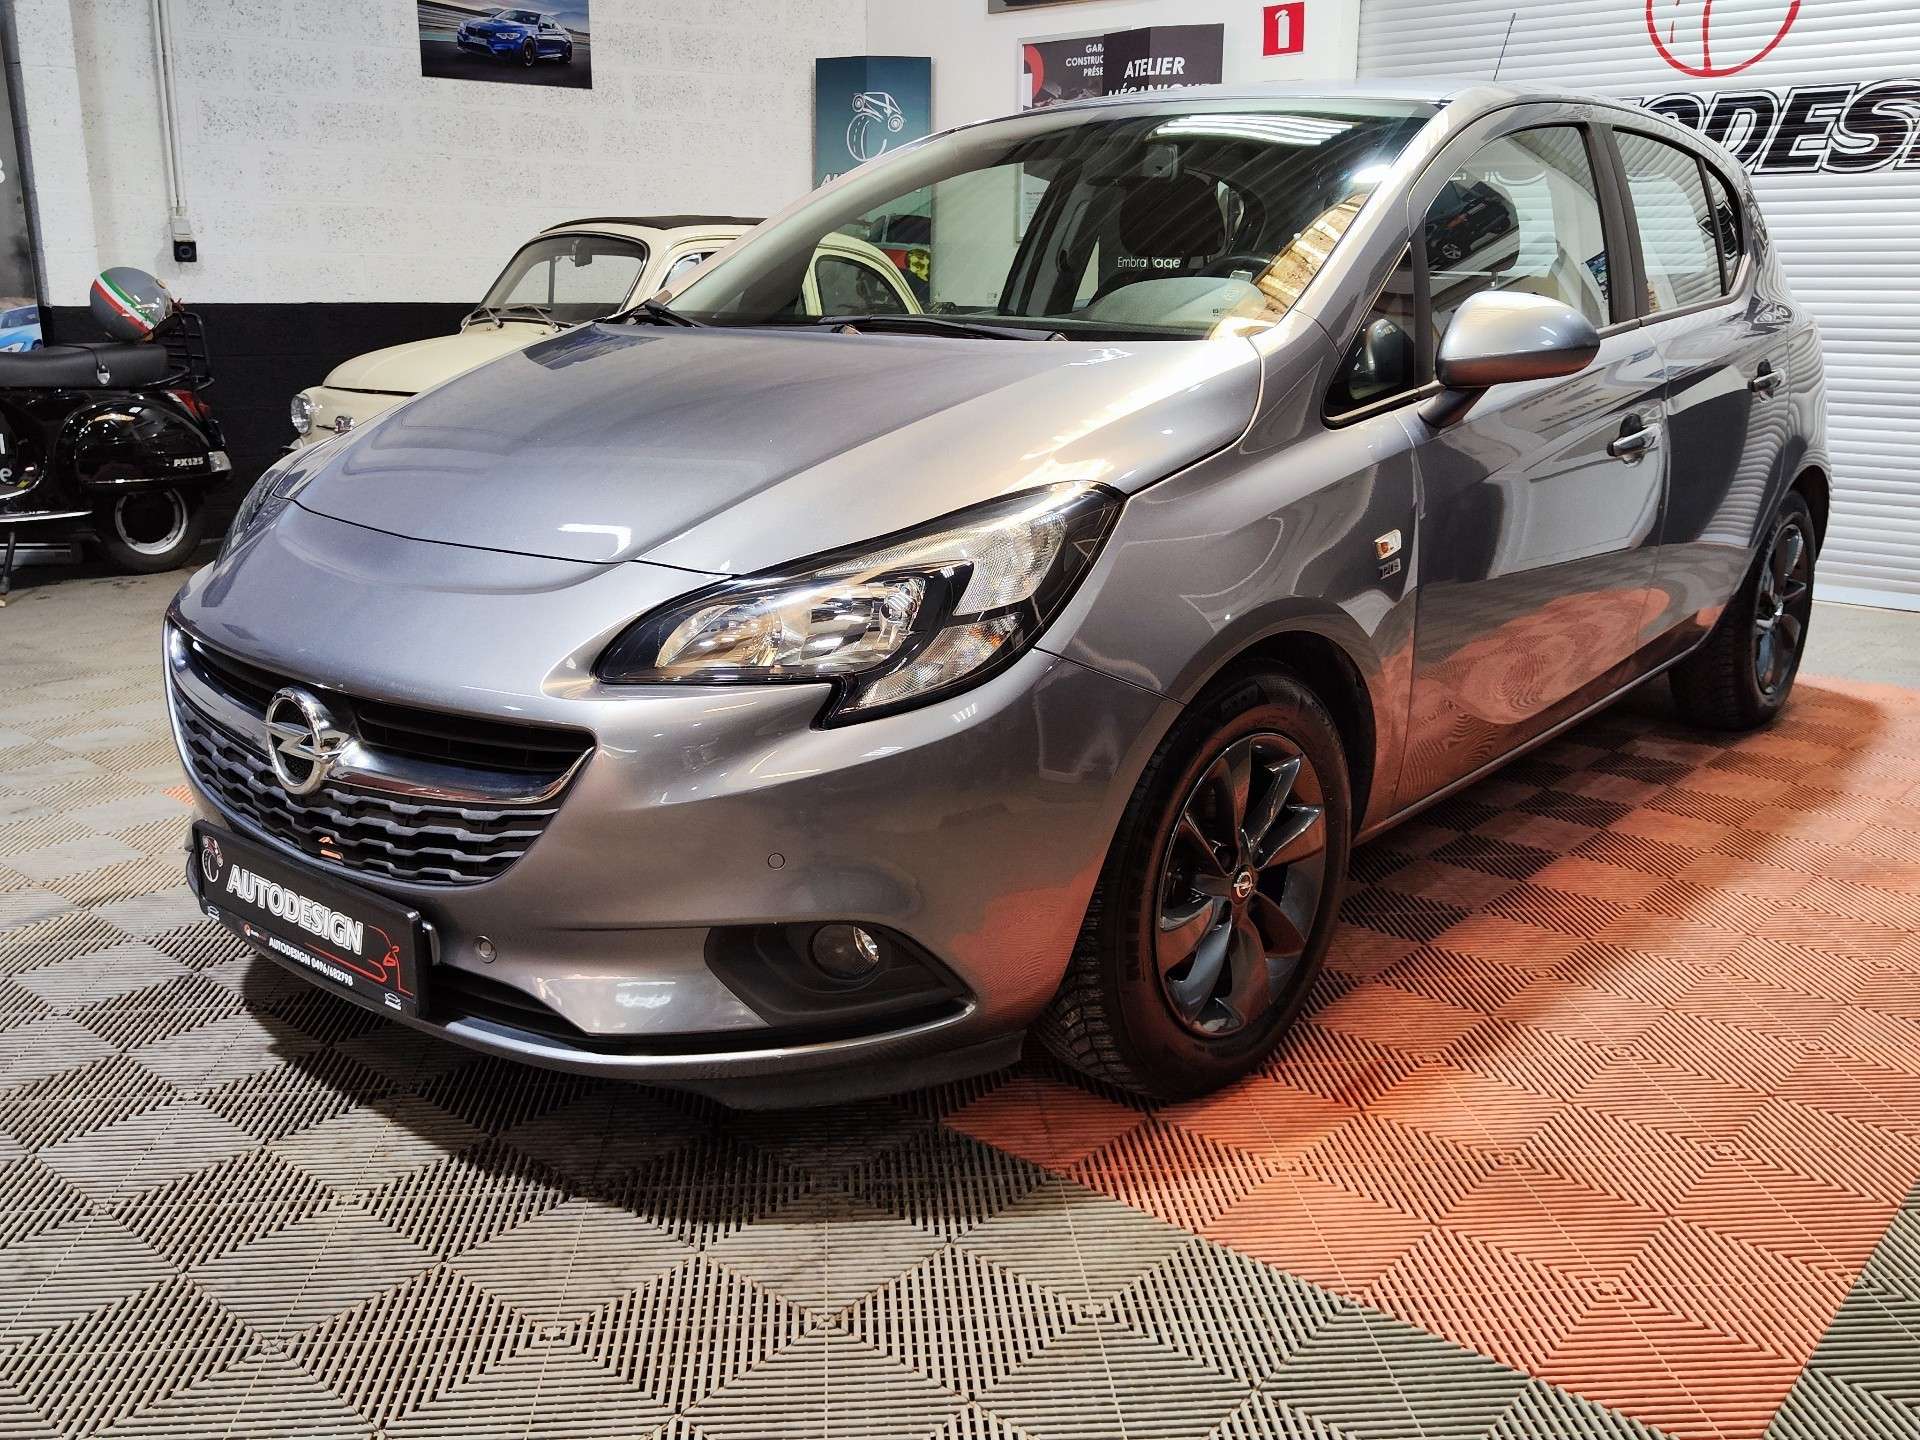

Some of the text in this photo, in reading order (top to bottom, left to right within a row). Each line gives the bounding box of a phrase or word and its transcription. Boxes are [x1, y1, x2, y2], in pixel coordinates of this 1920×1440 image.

[1085, 43, 1104, 53] GAR
[1124, 56, 1186, 79] ATELIER
[226, 864, 364, 956] AUTODESIGN
[268, 936, 311, 966] AUTODESIGN
